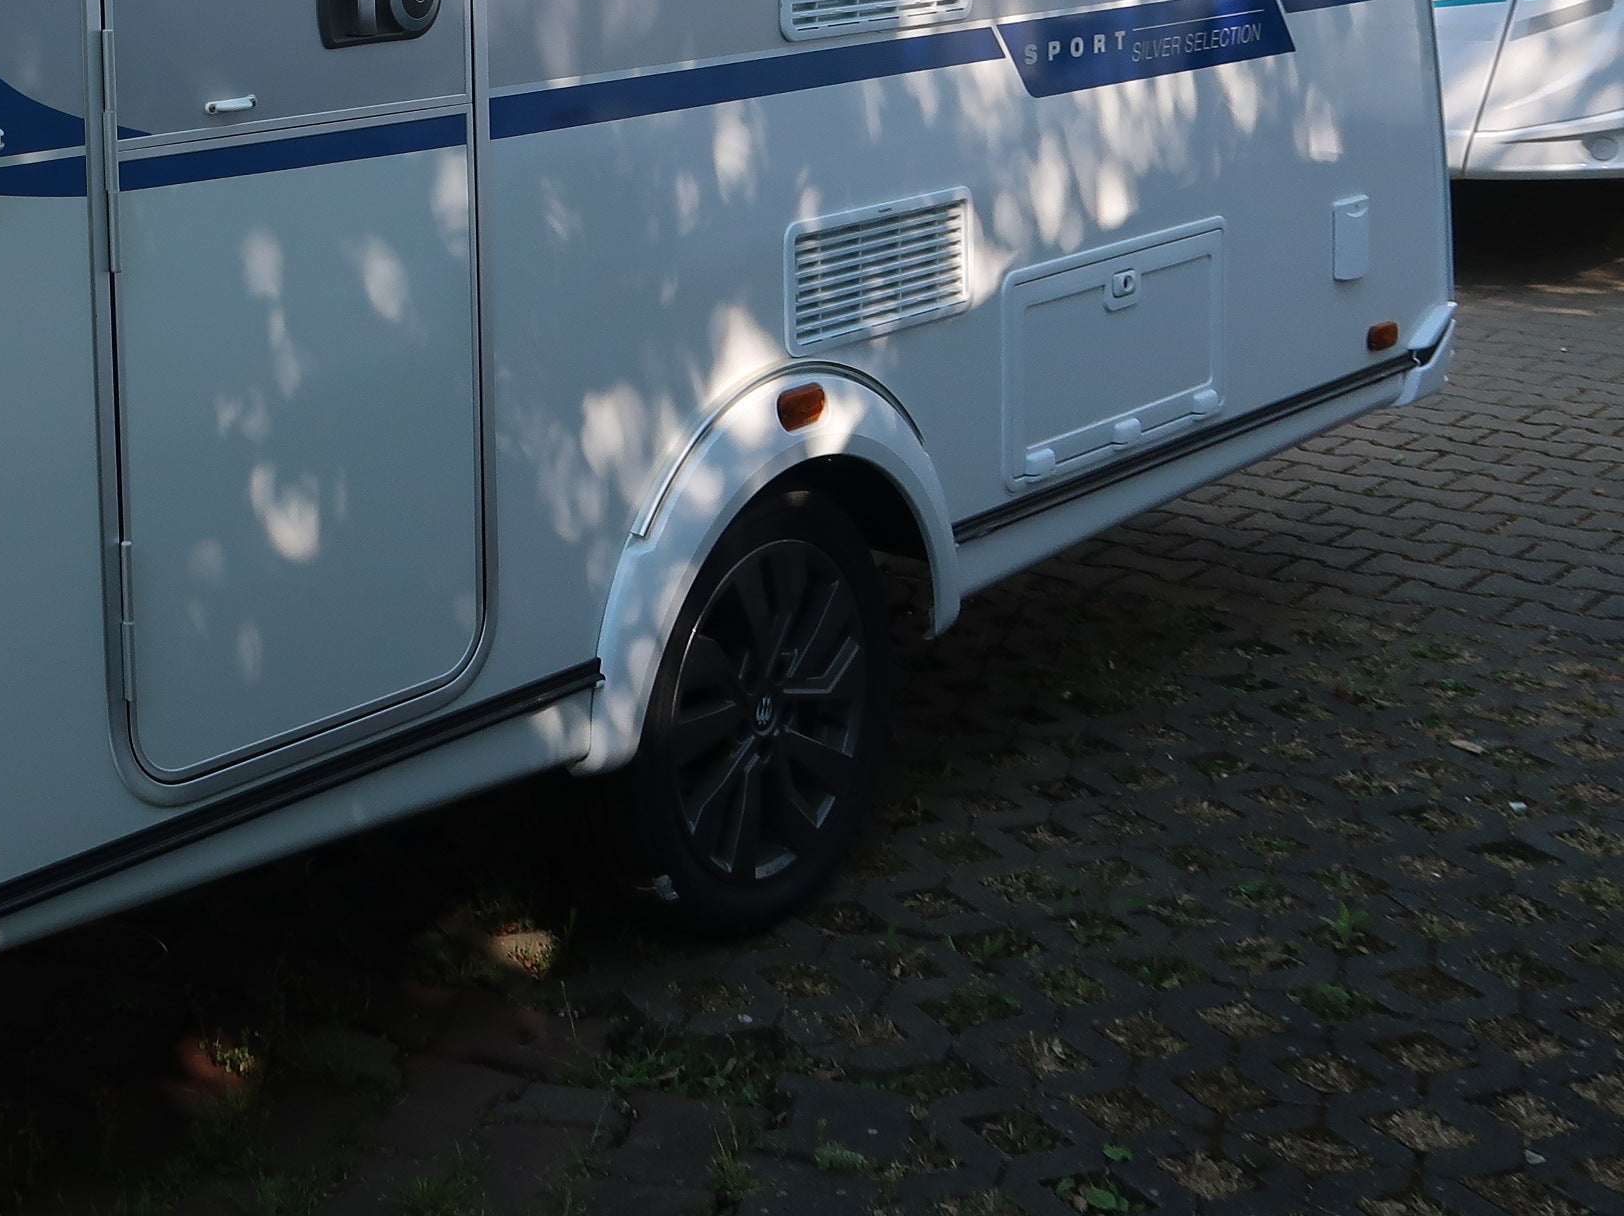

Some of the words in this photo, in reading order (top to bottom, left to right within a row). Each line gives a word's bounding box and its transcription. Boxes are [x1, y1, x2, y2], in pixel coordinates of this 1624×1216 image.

[1024, 30, 1126, 65] SPORT
[1131, 36, 1181, 62] SILVER
[1184, 23, 1262, 53] SELECTION
